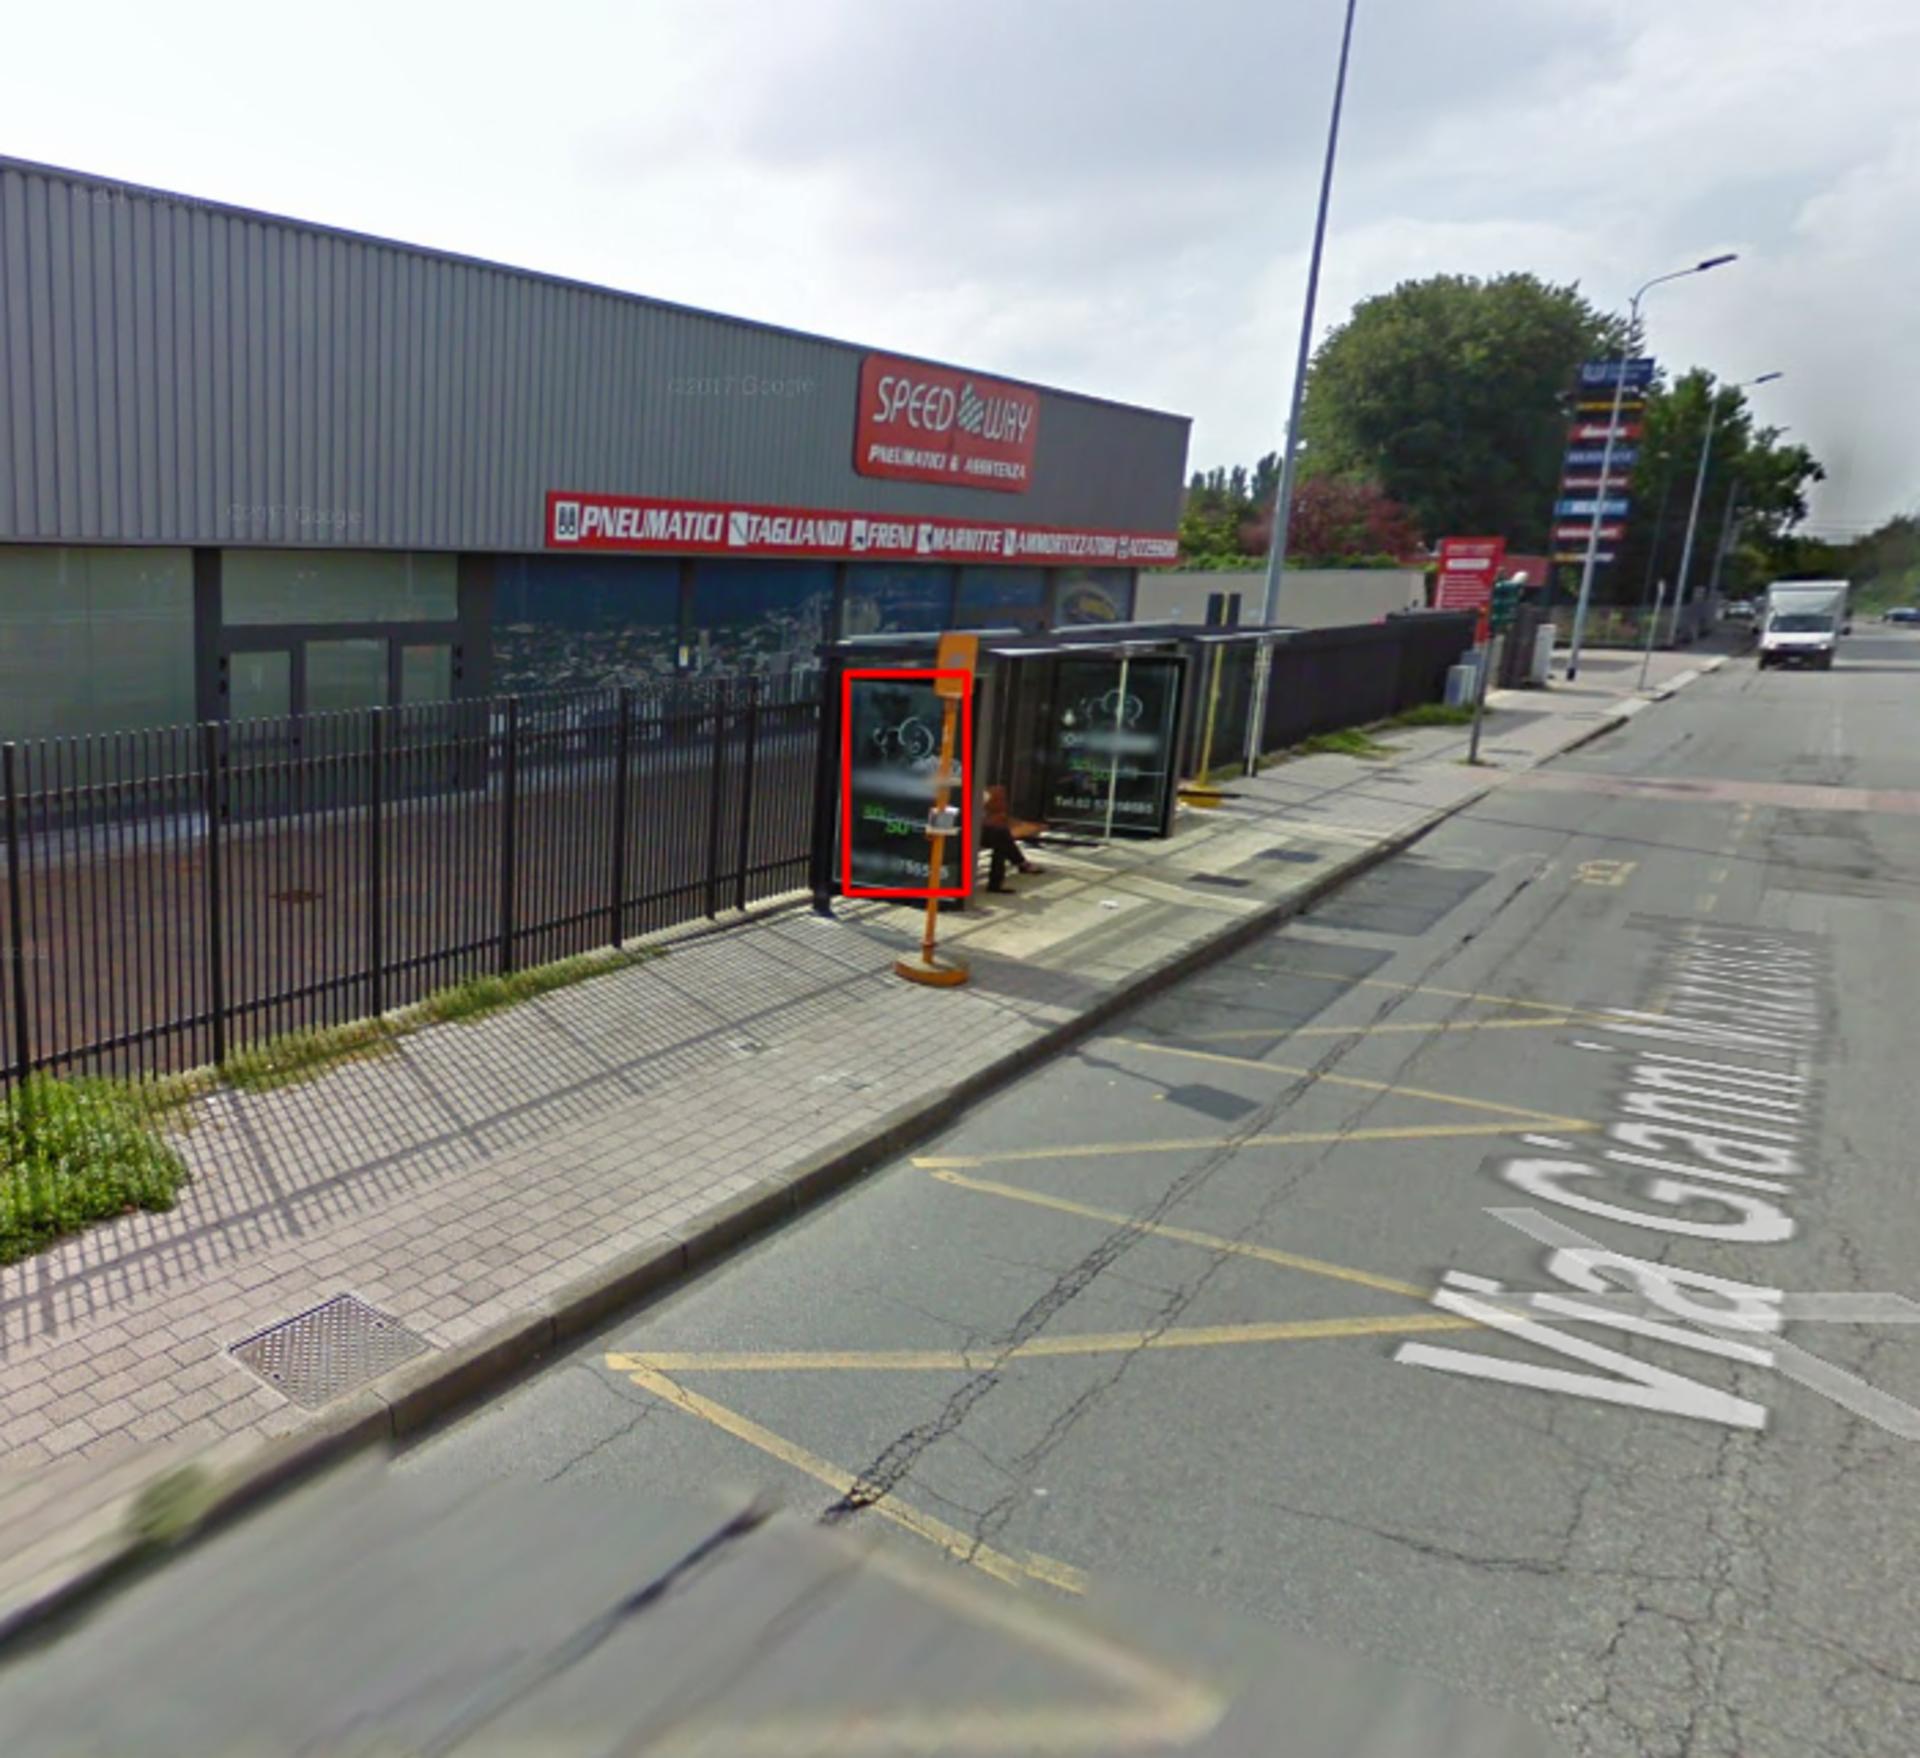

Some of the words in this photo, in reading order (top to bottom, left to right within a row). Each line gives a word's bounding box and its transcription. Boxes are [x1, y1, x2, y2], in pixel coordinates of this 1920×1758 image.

[872, 375, 956, 432] SPEED
[983, 396, 1033, 444] WAY
[867, 444, 947, 470] PNEUMATICI
[580, 505, 724, 542] PNEUMATICI
[748, 515, 848, 546] TAGLIANDI
[867, 522, 915, 549] FRENI
